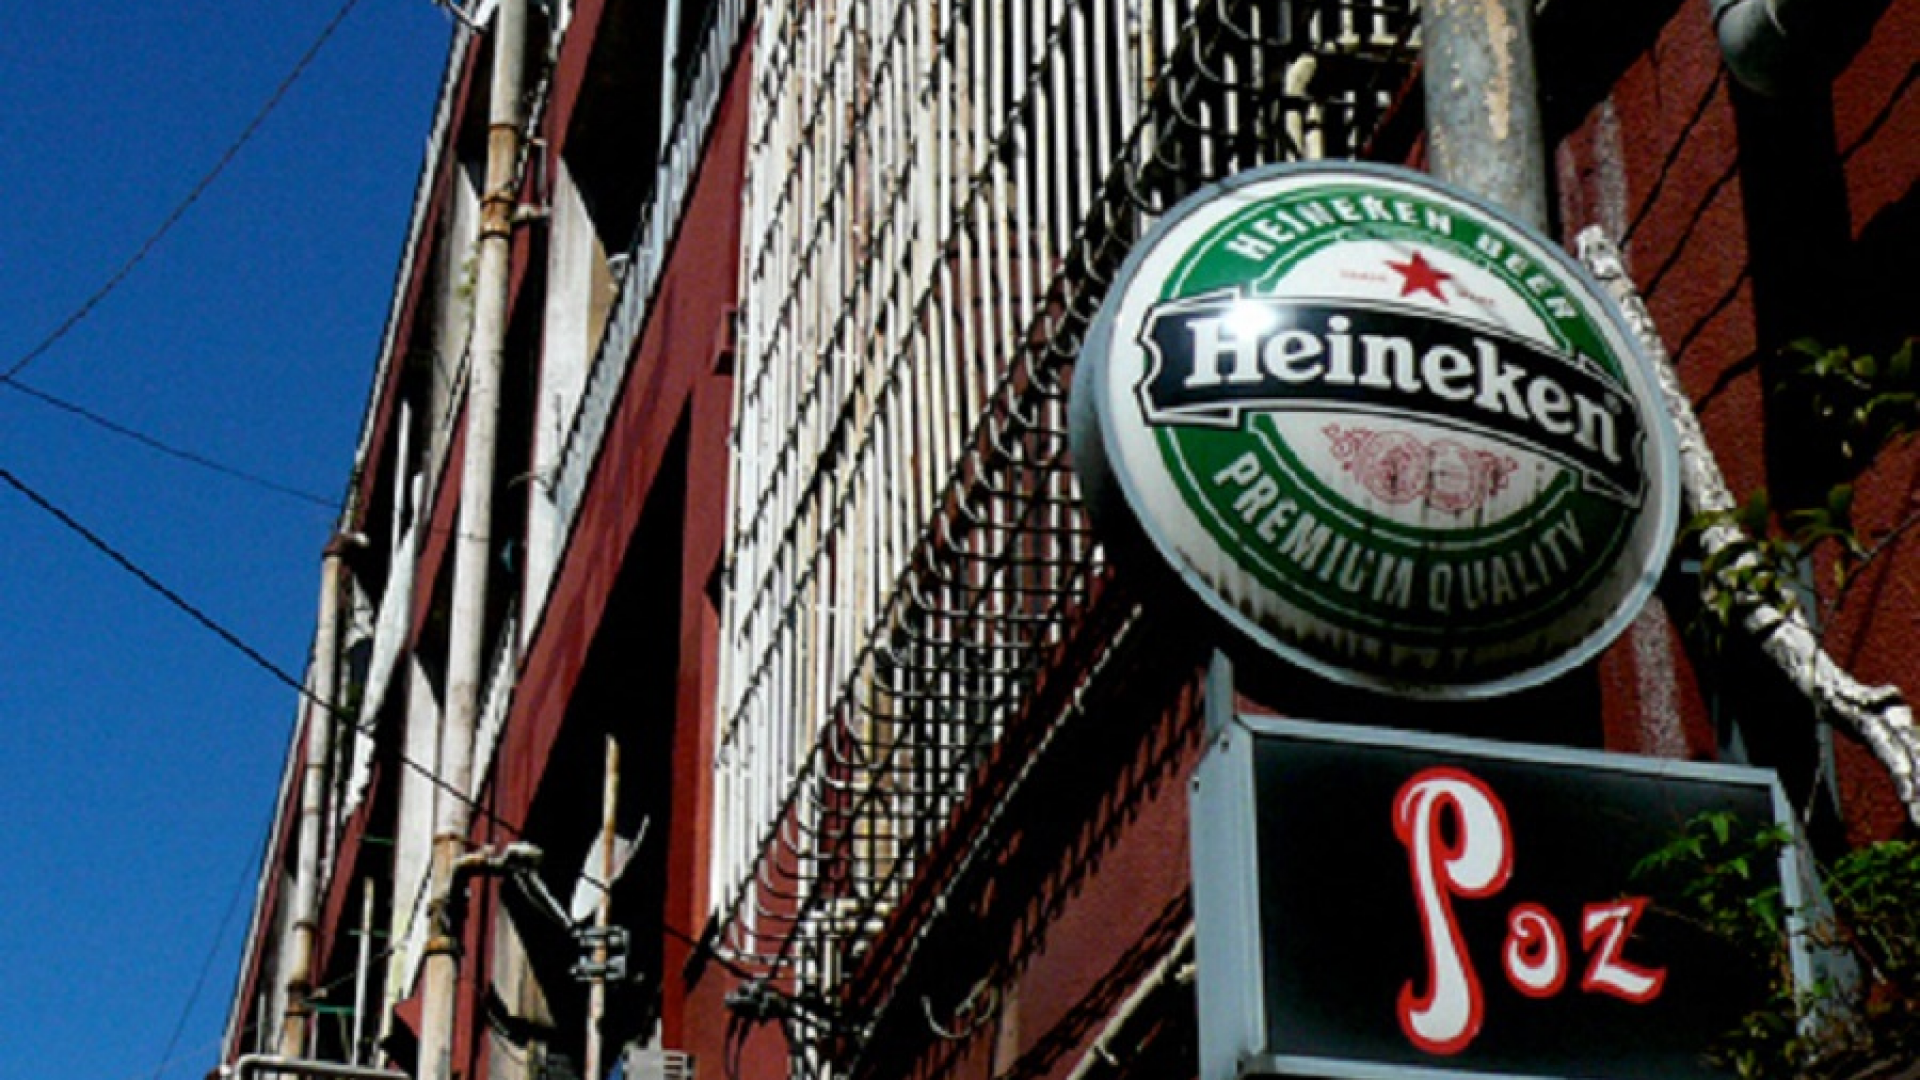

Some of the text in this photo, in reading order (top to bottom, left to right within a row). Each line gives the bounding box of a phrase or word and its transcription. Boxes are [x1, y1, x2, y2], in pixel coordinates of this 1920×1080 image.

[1224, 195, 1577, 319] HEINEKEN BEER
[1184, 315, 1622, 463] Heineken
[1213, 451, 1586, 618] PREMIUM QUALITY
[1392, 764, 1668, 1057] Poz
